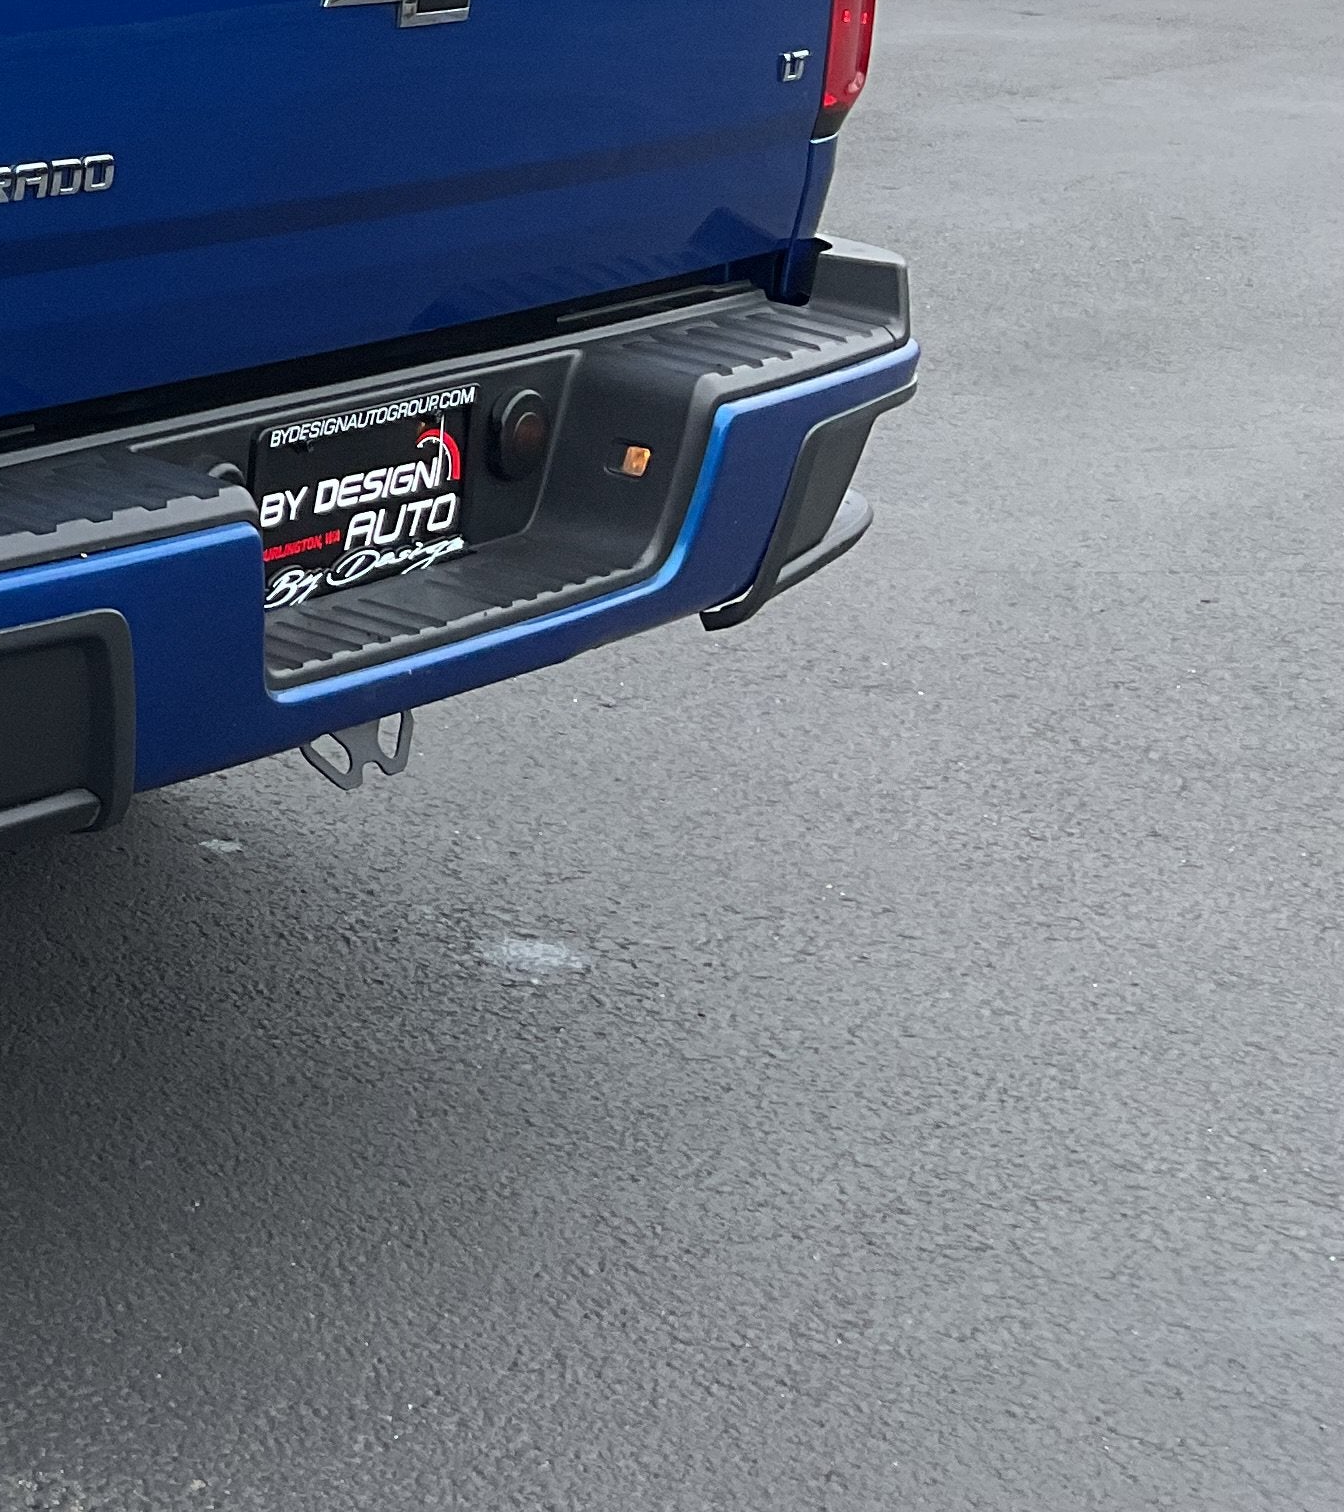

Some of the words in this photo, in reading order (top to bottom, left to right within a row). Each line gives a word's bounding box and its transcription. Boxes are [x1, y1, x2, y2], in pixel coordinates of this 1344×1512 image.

[269, 386, 476, 448] BYDESIGNAUTOGROUP.COM
[260, 486, 309, 529] BY
[314, 456, 442, 515] DESIGN
[344, 492, 457, 551] AUTO
[263, 534, 323, 562] URLINGTON,
[263, 569, 323, 609] By
